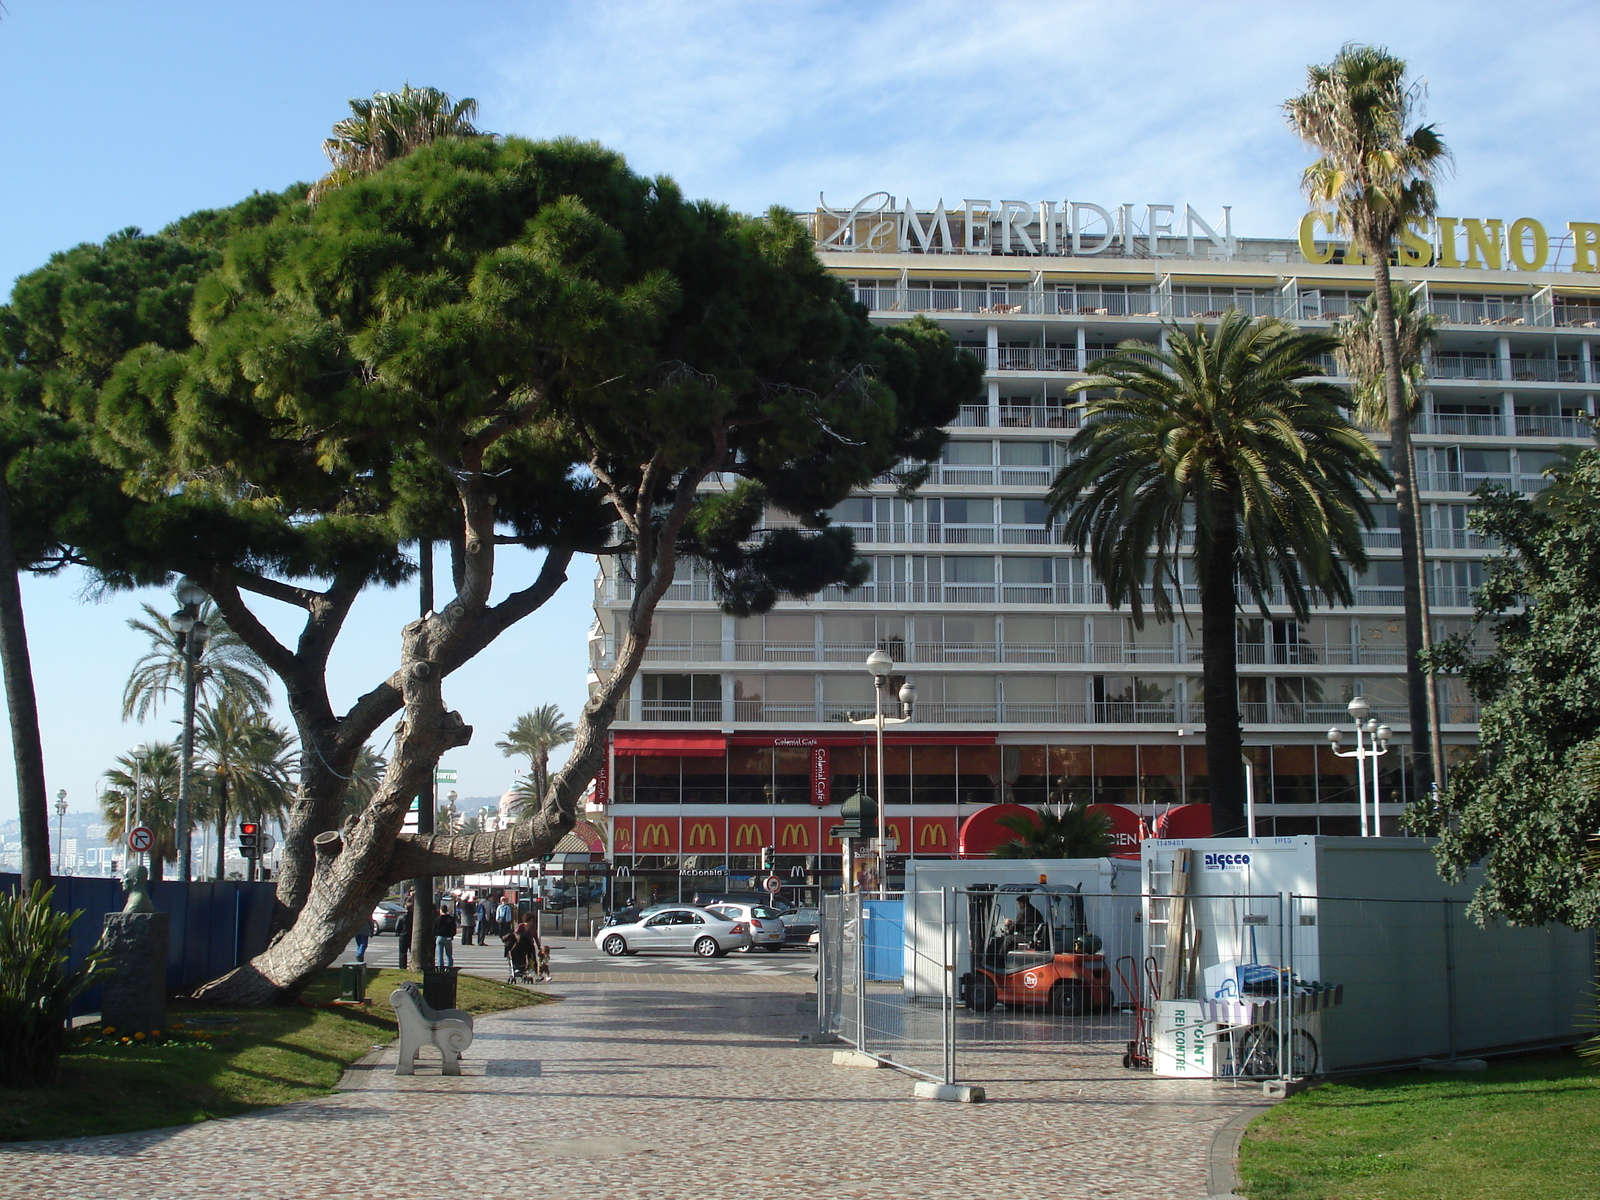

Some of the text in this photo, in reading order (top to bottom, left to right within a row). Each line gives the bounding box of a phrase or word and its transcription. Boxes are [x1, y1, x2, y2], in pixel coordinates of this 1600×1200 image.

[813, 191, 1233, 258] Le MERIDIEN
[1298, 210, 1549, 272] CSINO
[817, 748, 827, 780] Colonial
[678, 869, 729, 877] McDonald's
[1205, 853, 1251, 871] algeco
